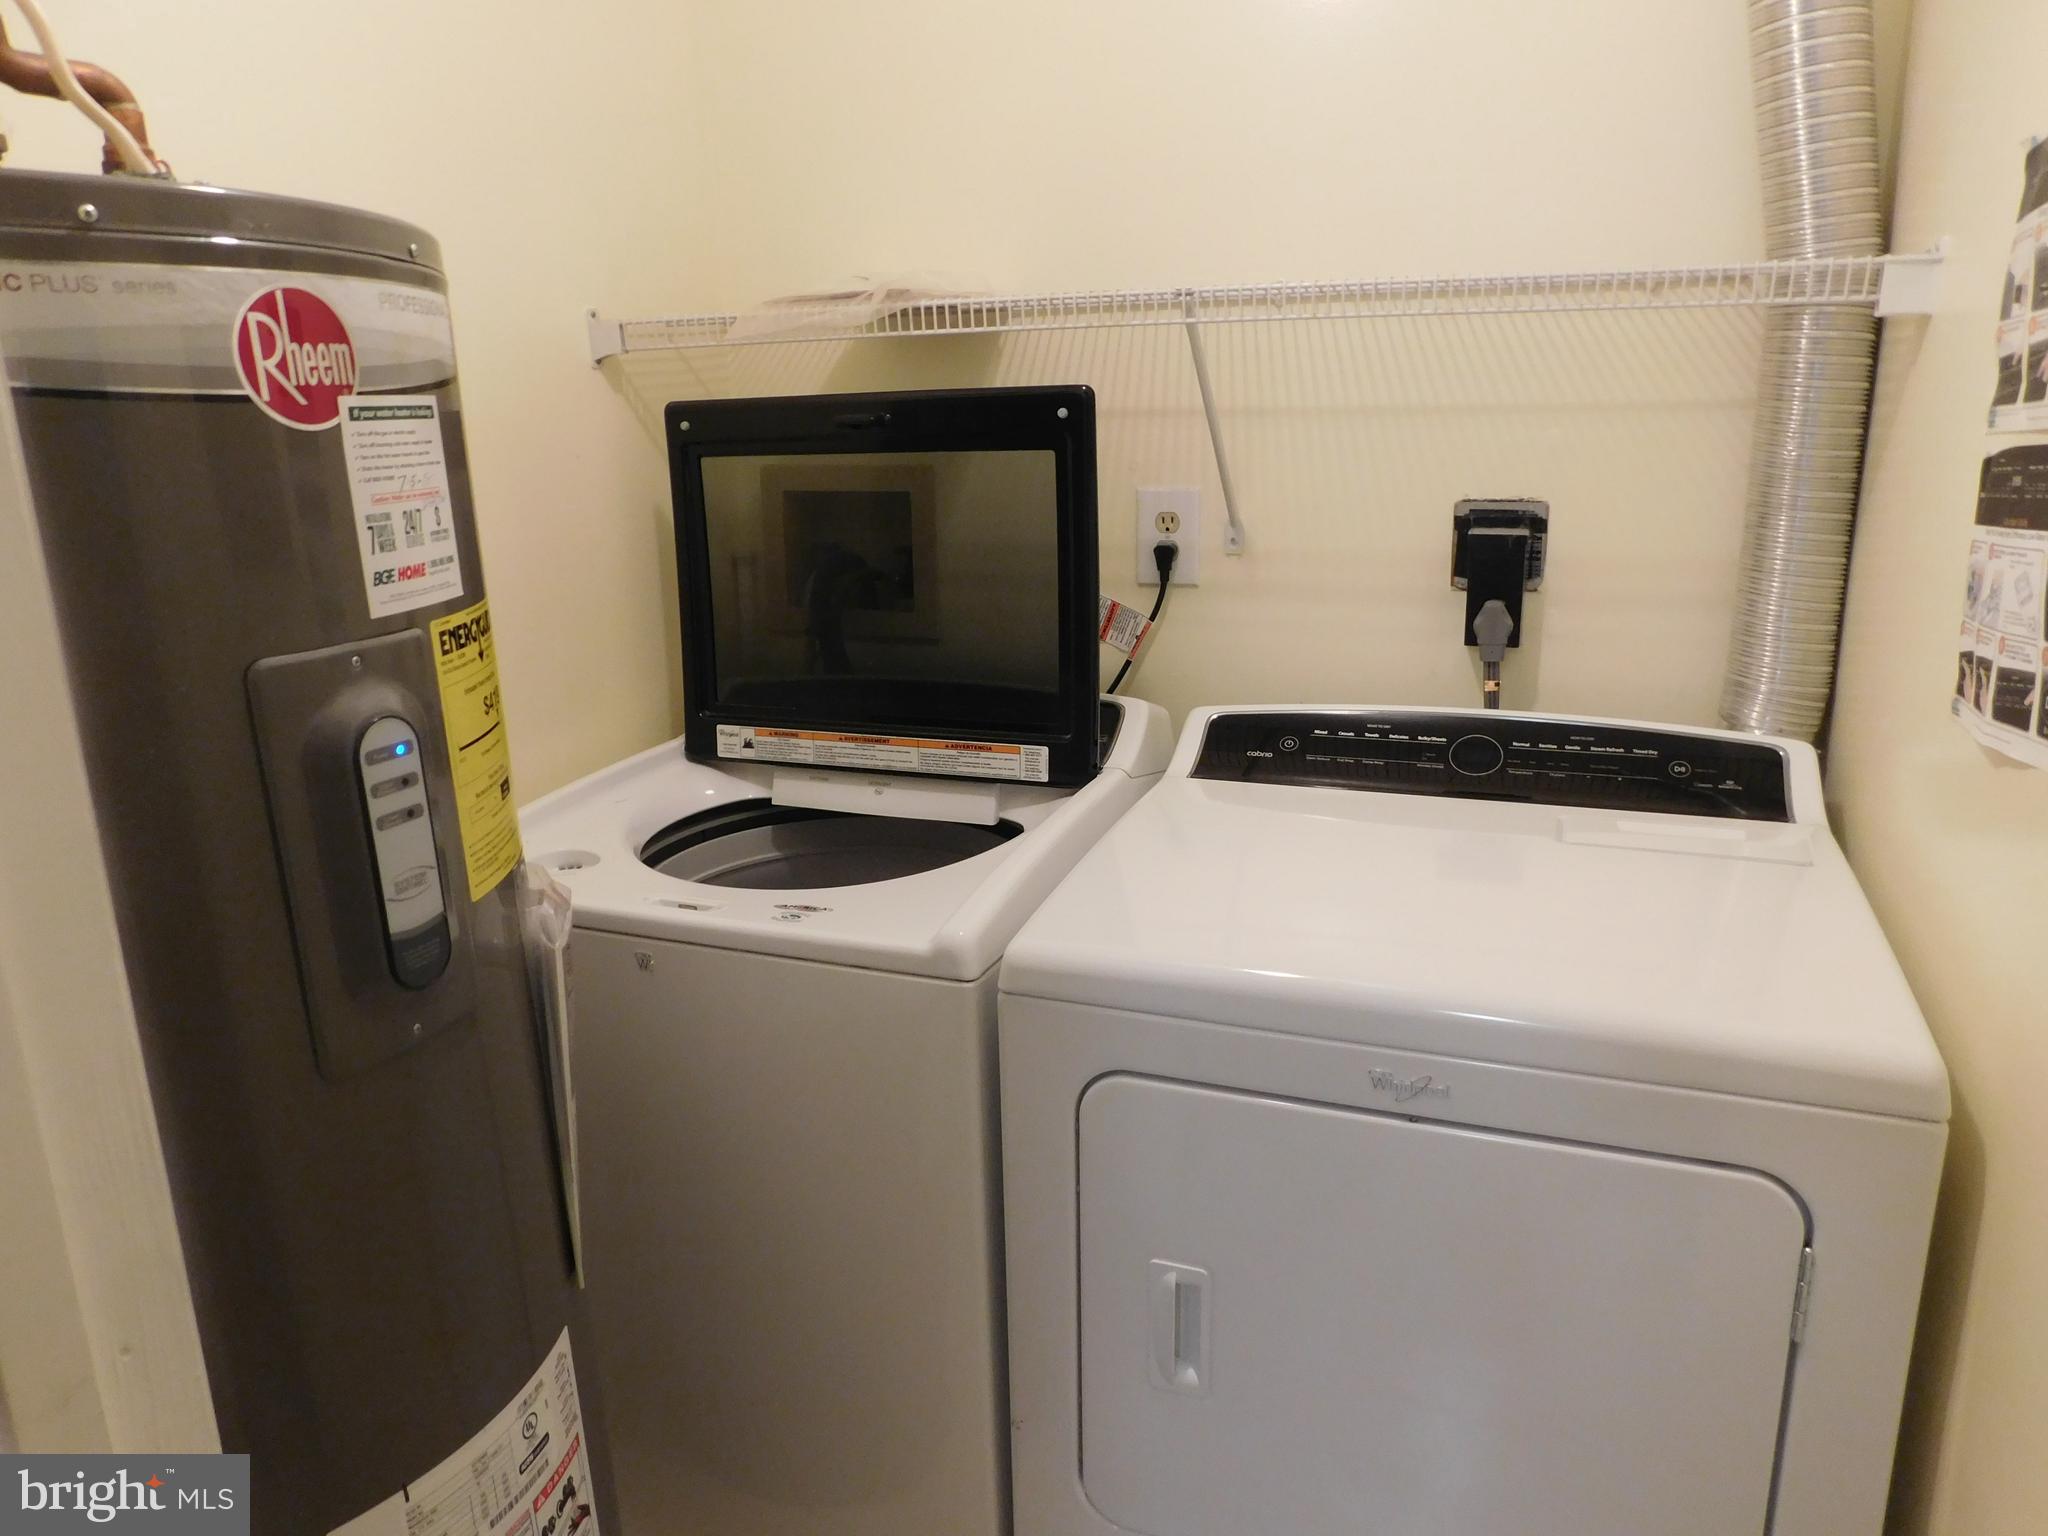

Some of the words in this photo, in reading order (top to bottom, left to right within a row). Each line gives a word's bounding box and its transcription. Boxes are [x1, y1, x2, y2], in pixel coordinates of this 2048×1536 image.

[29, 274, 98, 294] PLUS
[246, 288, 355, 405] Rheem
[367, 525, 376, 556] 7
[373, 568, 396, 587] BGE
[398, 562, 427, 582] HOME
[950, 743, 993, 752] ADVERTENCIA
[1246, 749, 1273, 758] cabrio
[1368, 1071, 1451, 1102] Whirlpool
[546, 1436, 580, 1494] DANGER
